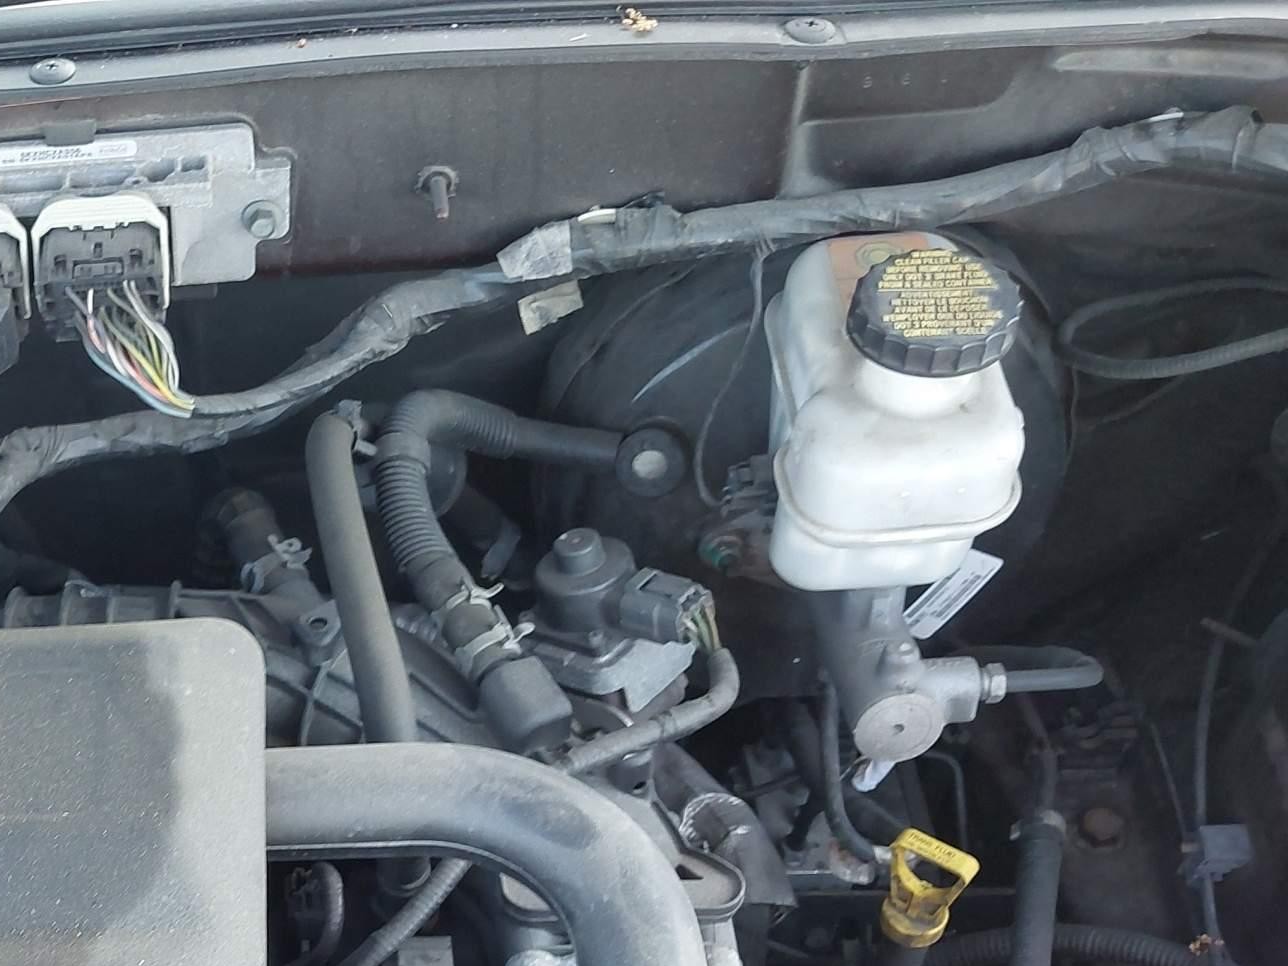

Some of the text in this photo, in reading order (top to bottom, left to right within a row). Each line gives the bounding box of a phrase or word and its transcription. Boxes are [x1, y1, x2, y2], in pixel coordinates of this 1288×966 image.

[894, 257, 921, 266] CLEAN
[922, 256, 951, 265] FILLER
[882, 272, 903, 281] ONLY
[904, 272, 922, 280] DOT
[912, 279, 944, 288] SEALED
